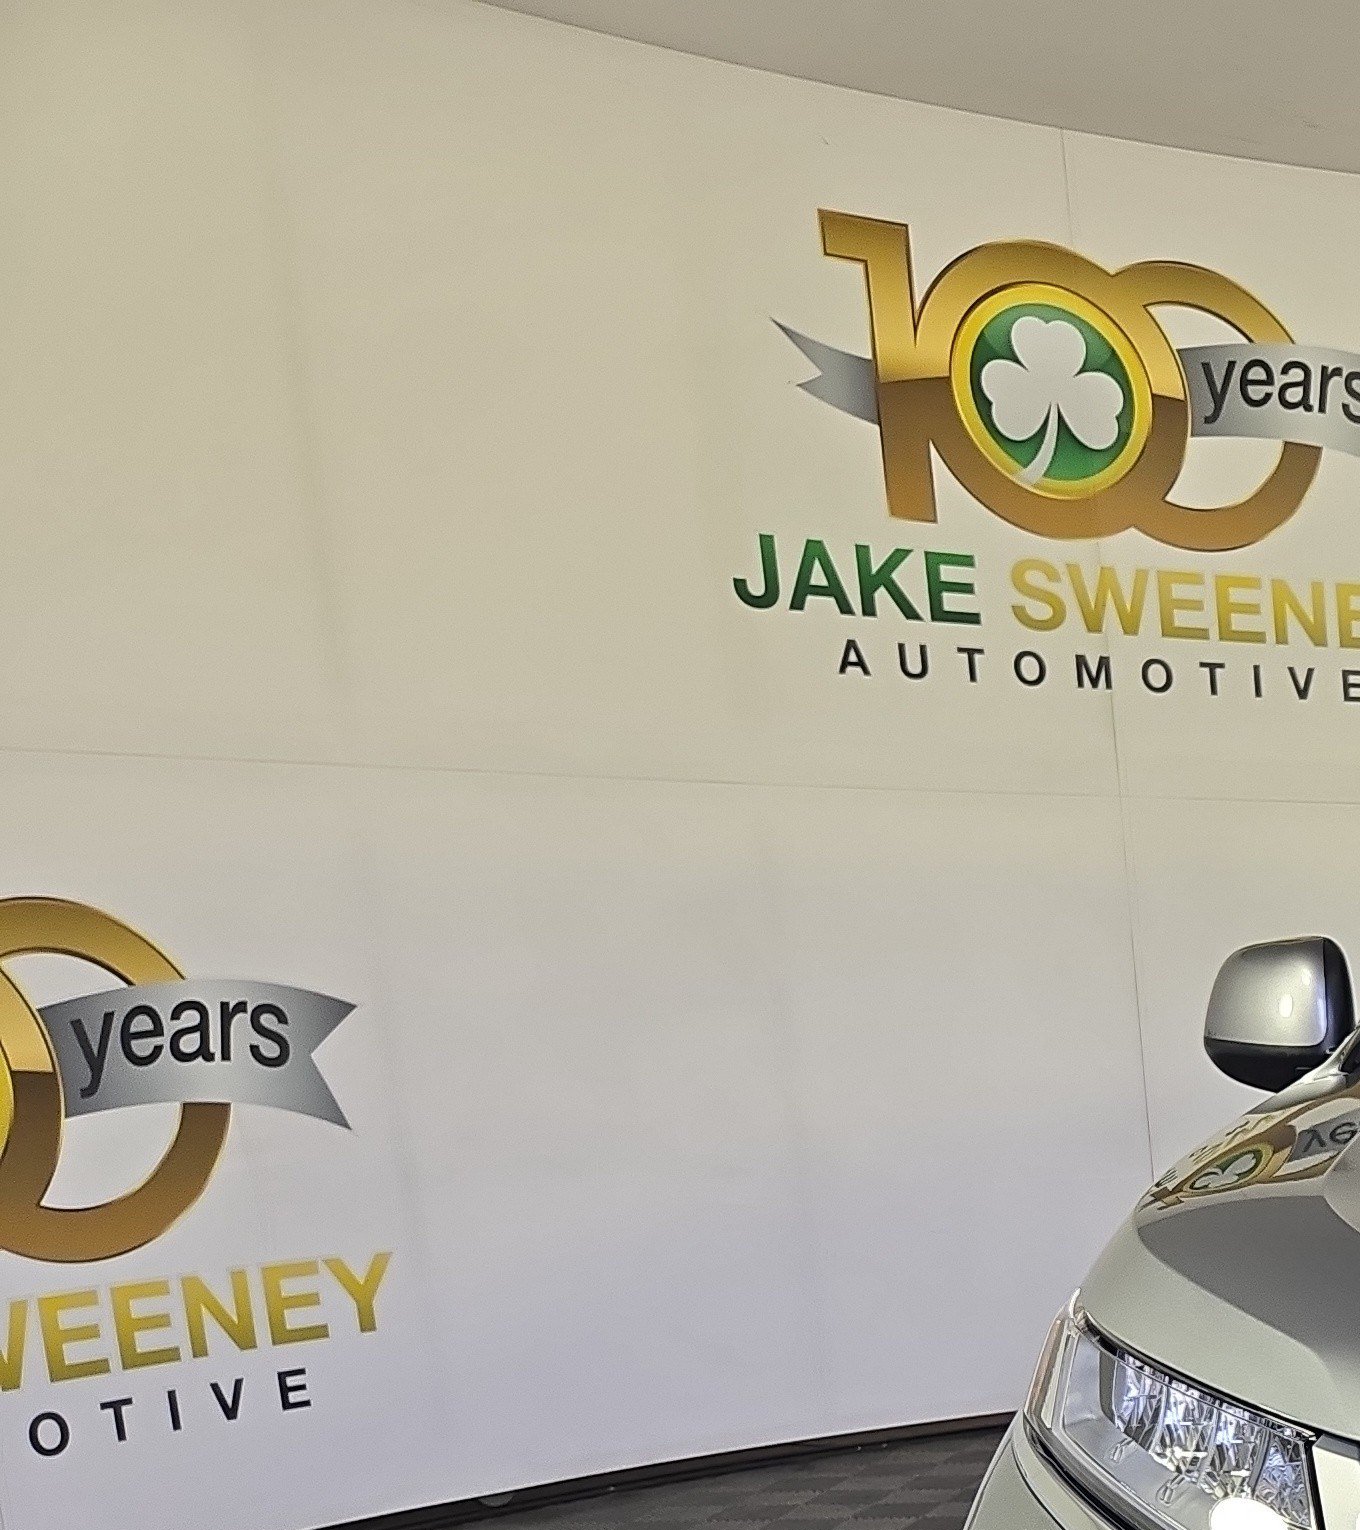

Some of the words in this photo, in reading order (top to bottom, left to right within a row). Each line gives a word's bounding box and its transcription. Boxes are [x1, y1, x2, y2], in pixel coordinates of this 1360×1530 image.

[817, 208, 1323, 553] 100
[732, 533, 982, 626] JAKE
[70, 999, 291, 1099] years
[28, 1367, 312, 1457] OTIVE
